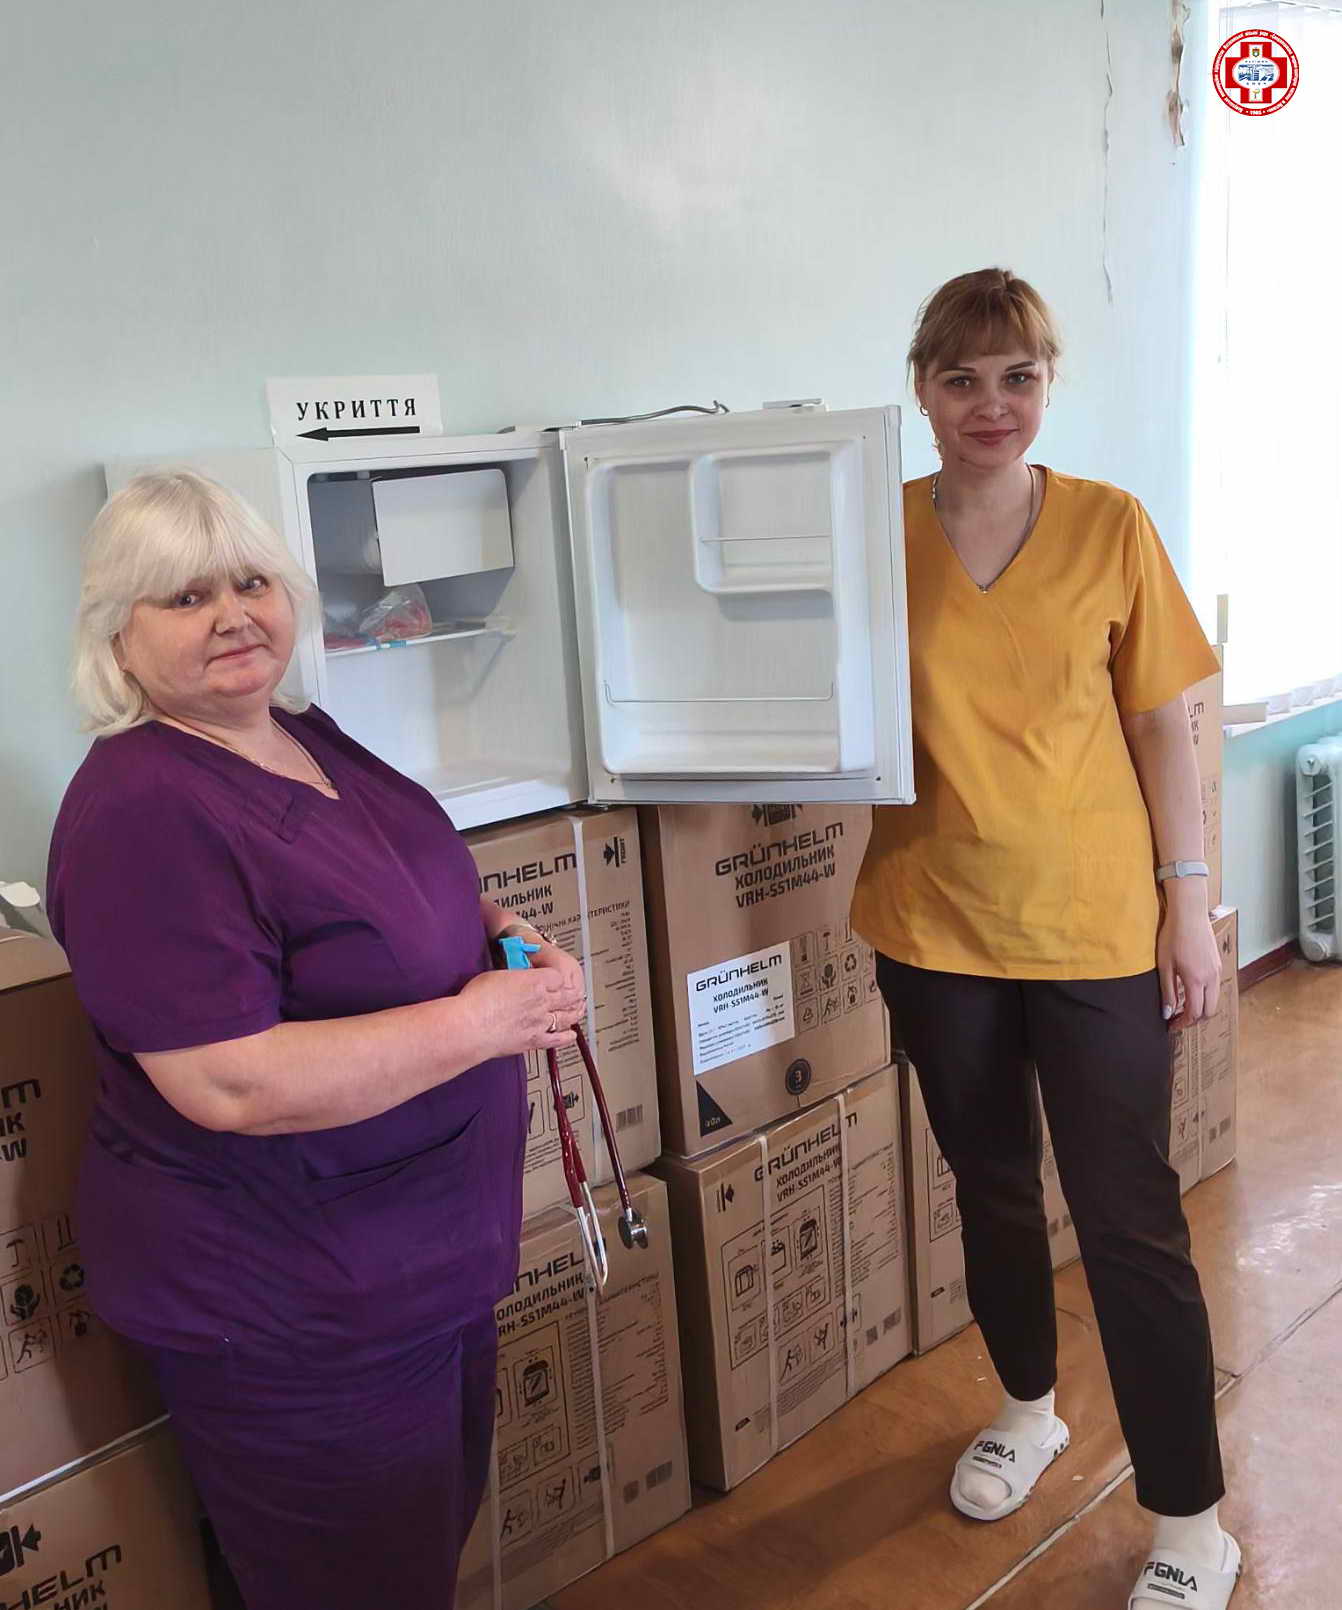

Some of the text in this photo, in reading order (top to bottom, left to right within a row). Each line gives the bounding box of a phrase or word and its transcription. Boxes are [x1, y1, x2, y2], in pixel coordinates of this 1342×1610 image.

[296, 398, 416, 421] УКРИТТЯ
[715, 822, 843, 876] GRÜNHELM
[735, 845, 834, 890] ХОЛОДИЛЬНИК
[480, 852, 577, 893] NHELM
[493, 884, 553, 908] ИЛЬНИК
[696, 954, 782, 991] GRÜNHELM
[713, 977, 768, 1003] ХОЛОДИЛЬНИК
[496, 1272, 584, 1322] ОЛОДИЛЬНИК
[0, 1544, 122, 1610] HELM
